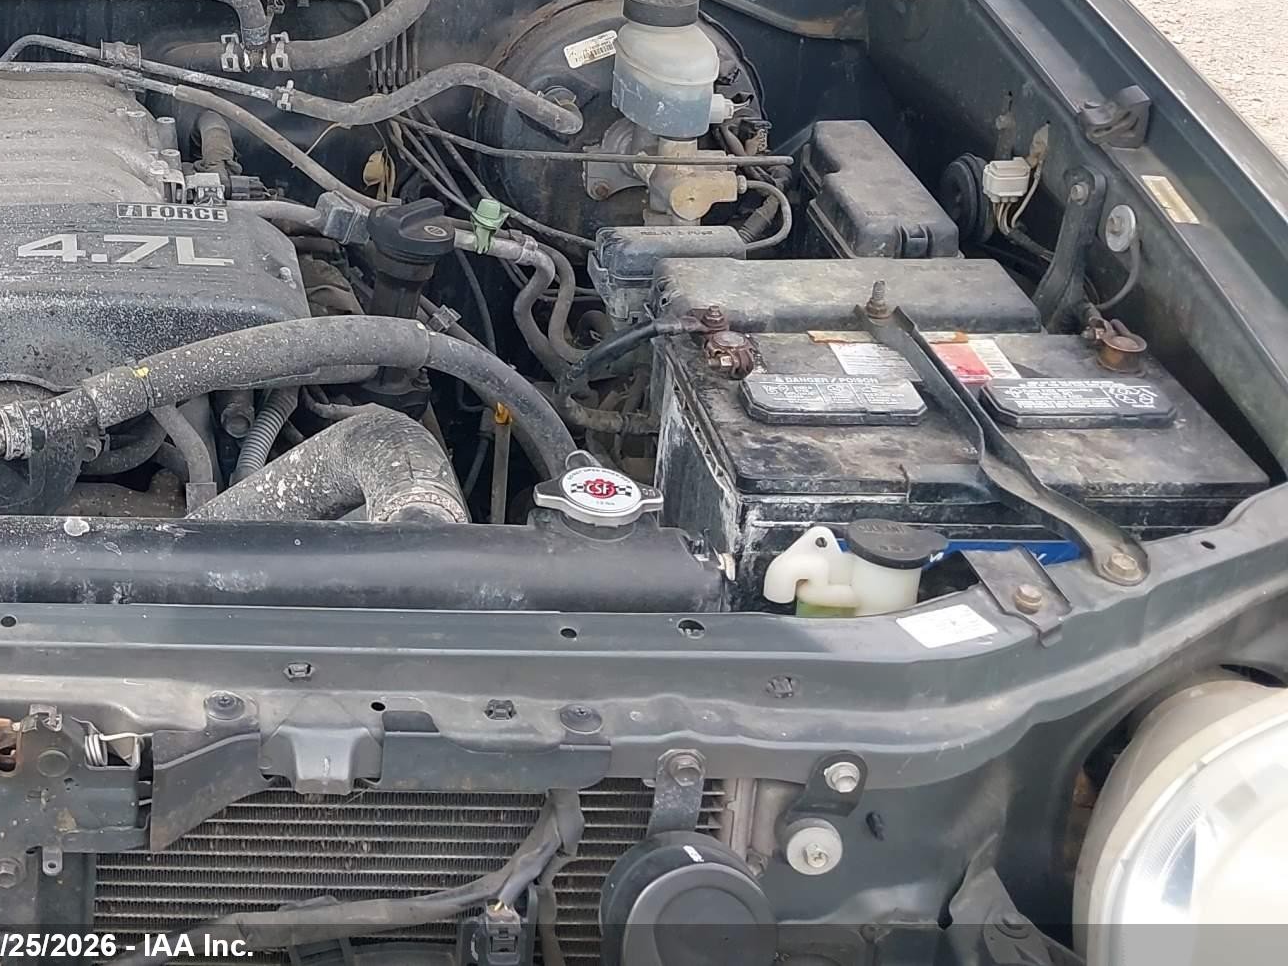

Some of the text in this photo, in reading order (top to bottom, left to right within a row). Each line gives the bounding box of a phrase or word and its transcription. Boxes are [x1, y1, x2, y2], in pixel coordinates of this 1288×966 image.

[145, 205, 226, 221] FORCE
[15, 233, 235, 267] 4.7L
[785, 376, 829, 384] DANGER
[586, 482, 610, 495] CSF
